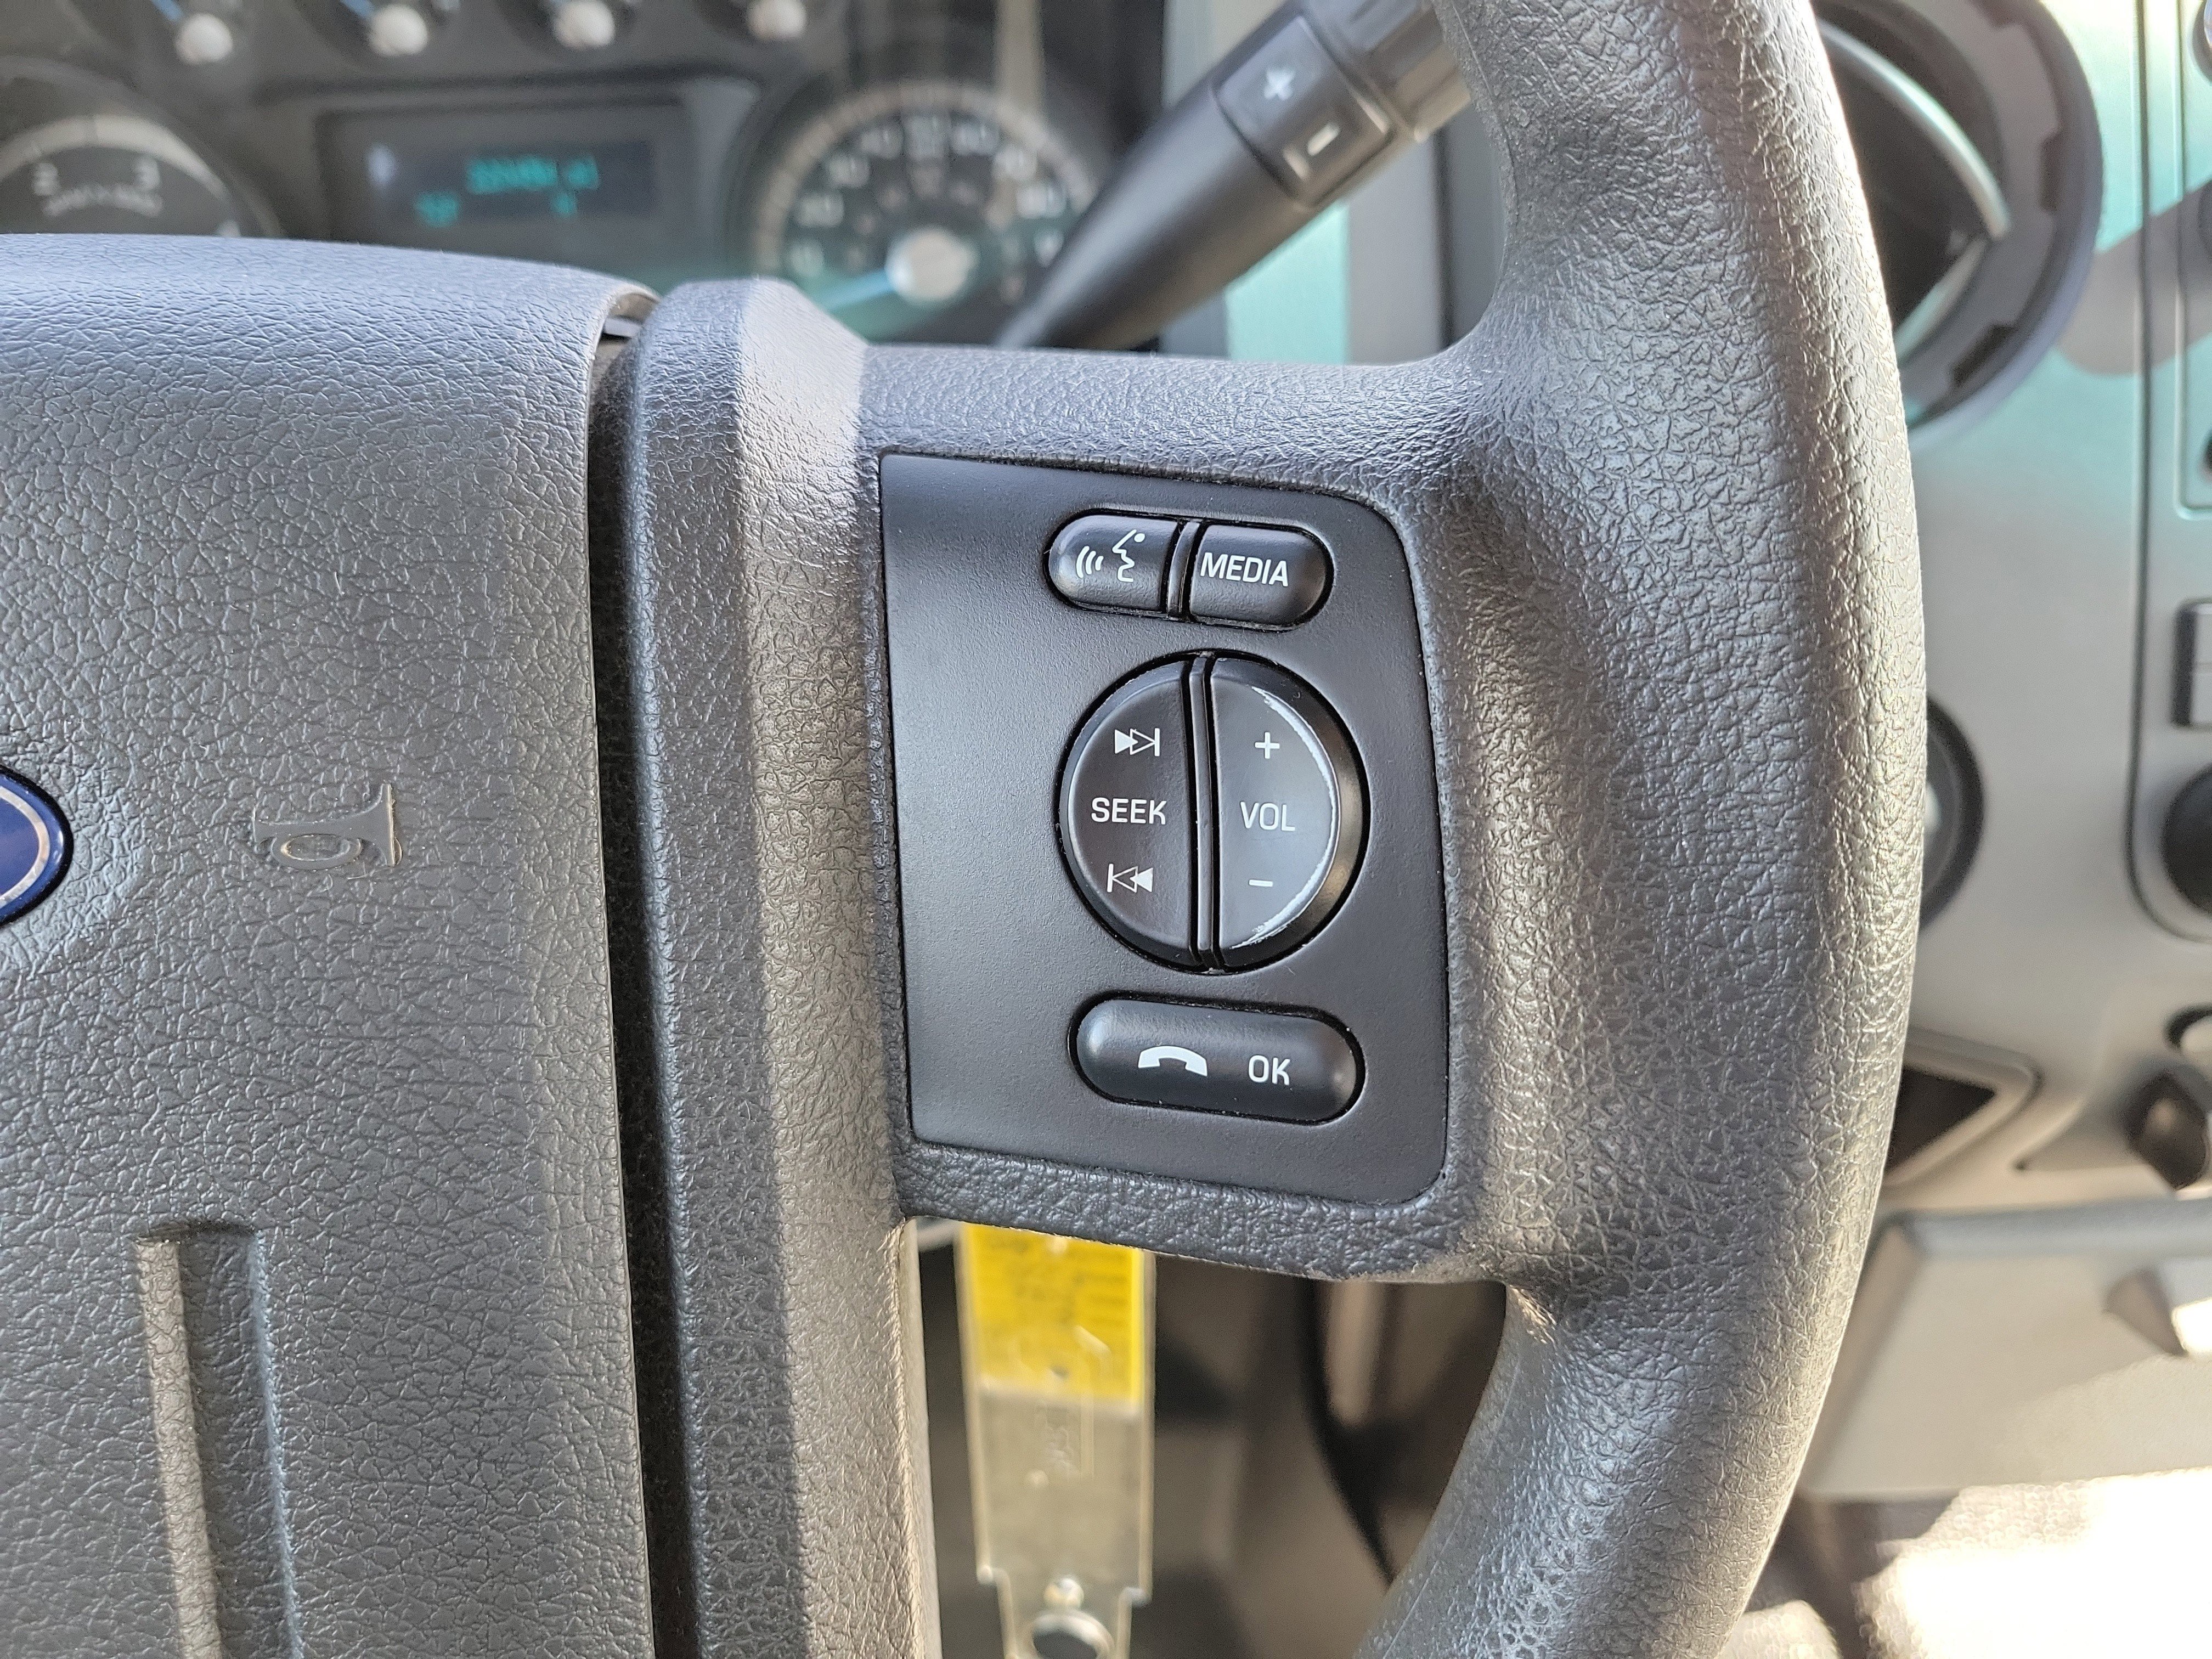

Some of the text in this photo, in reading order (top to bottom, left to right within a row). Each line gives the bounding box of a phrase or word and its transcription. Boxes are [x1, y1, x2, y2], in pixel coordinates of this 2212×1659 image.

[1200, 552, 1289, 587] MEDIA
[1091, 797, 1167, 825] SEEK
[1240, 802, 1296, 831] VOL
[1248, 1055, 1290, 1085] OK
